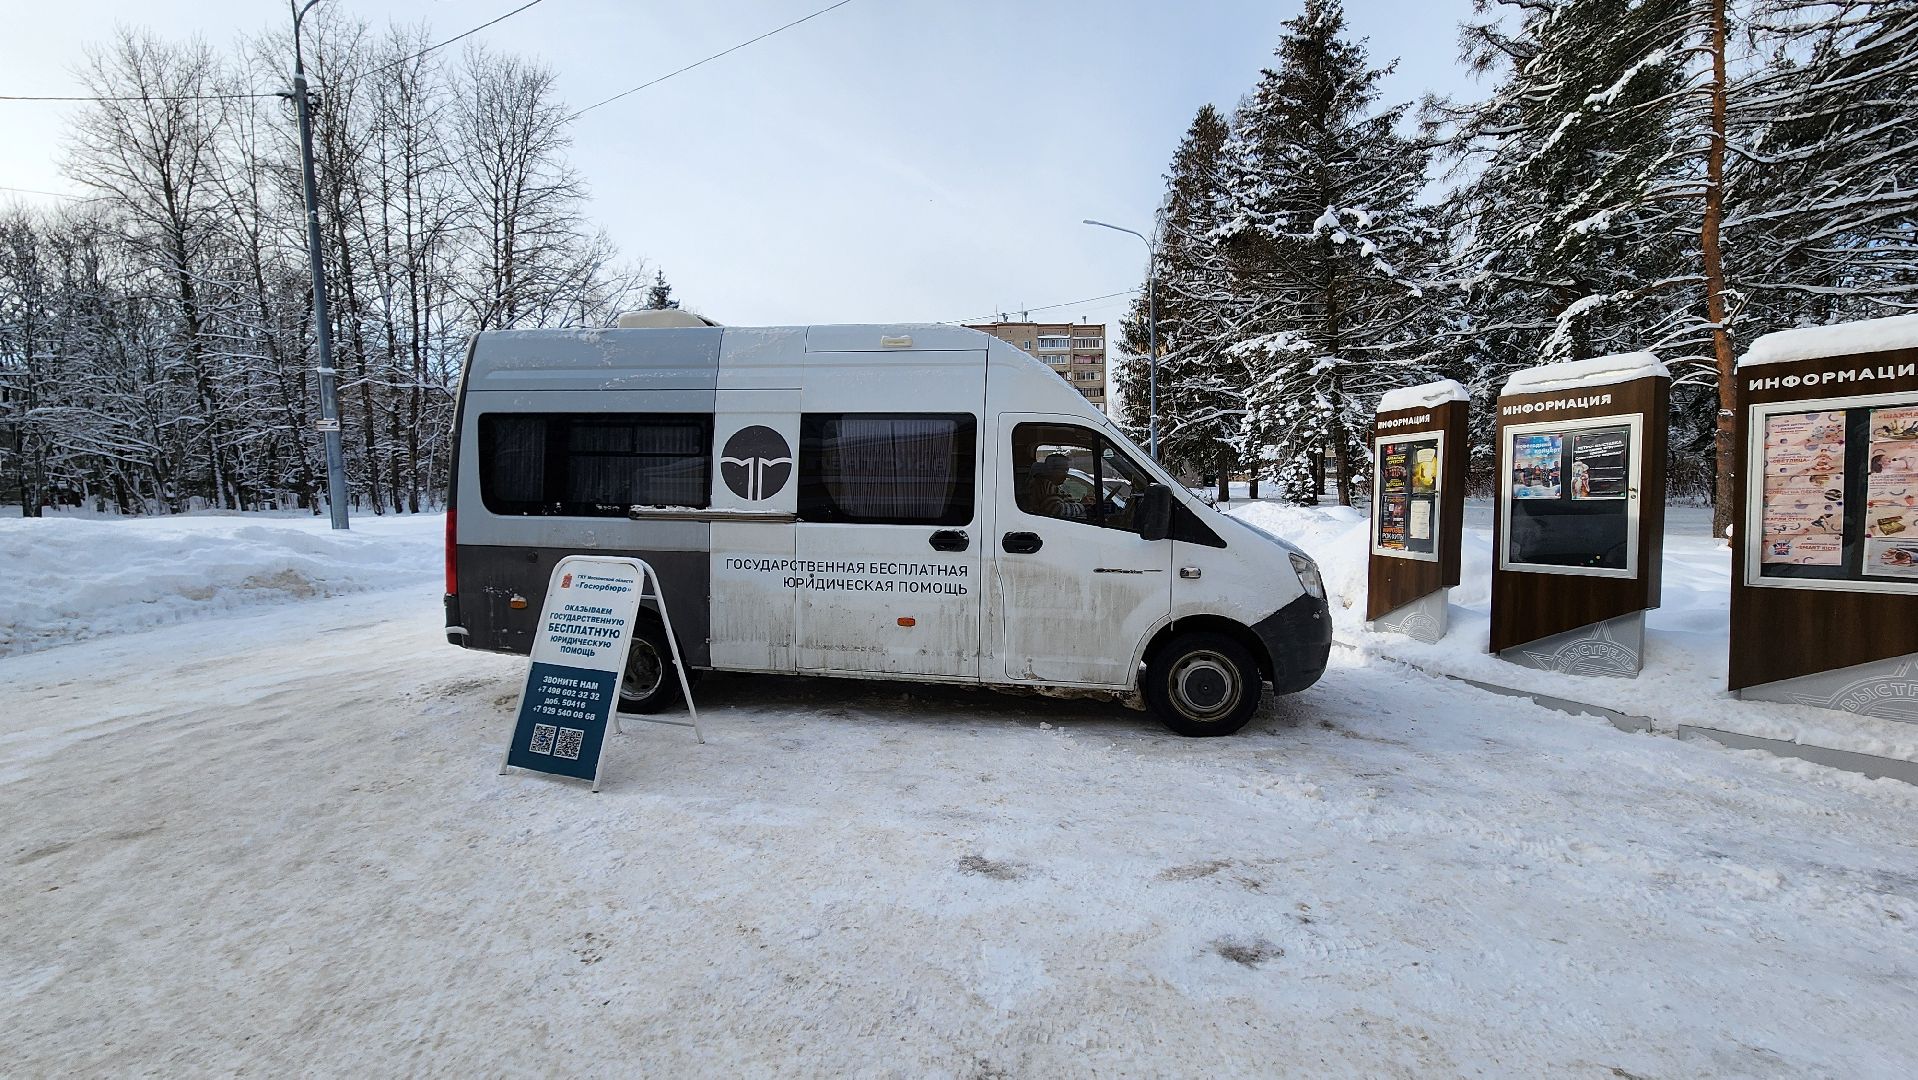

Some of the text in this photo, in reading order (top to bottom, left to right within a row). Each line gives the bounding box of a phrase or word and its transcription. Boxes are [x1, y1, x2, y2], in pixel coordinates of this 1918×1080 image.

[1749, 363, 1918, 391] ИНФОРМАЦИ
[1502, 394, 1612, 416] ИНФОРМАЦИЯ
[1377, 413, 1431, 430] ИНФОРМАЦИЯ
[726, 558, 968, 577] ГОСУДАРСТВЕННАЯ БЕСПЛАТНАЯ
[783, 576, 968, 597] ЮРИДИЧЕСКАЯ ПОМОЩЬ
[564, 604, 613, 615] ОКАЗЫВАЕМ
[549, 612, 625, 626] ГОСУДАРСТВЕННУЮ
[548, 622, 621, 639] БЕСПЛАТНУЮ
[550, 635, 612, 648] ЮРИДИЧЕСКУЮ
[559, 645, 596, 657] ПОМОЩЬ
[542, 675, 599, 690] ЗВОНИТЕ НАМ
[547, 687, 561, 695] 498
[561, 688, 577, 697] 602
[577, 690, 589, 699] 32
[589, 692, 600, 701] 32
[561, 699, 586, 709] 50416
[542, 706, 556, 715] 929
[556, 708, 572, 717] 540
[572, 711, 584, 719] 08
